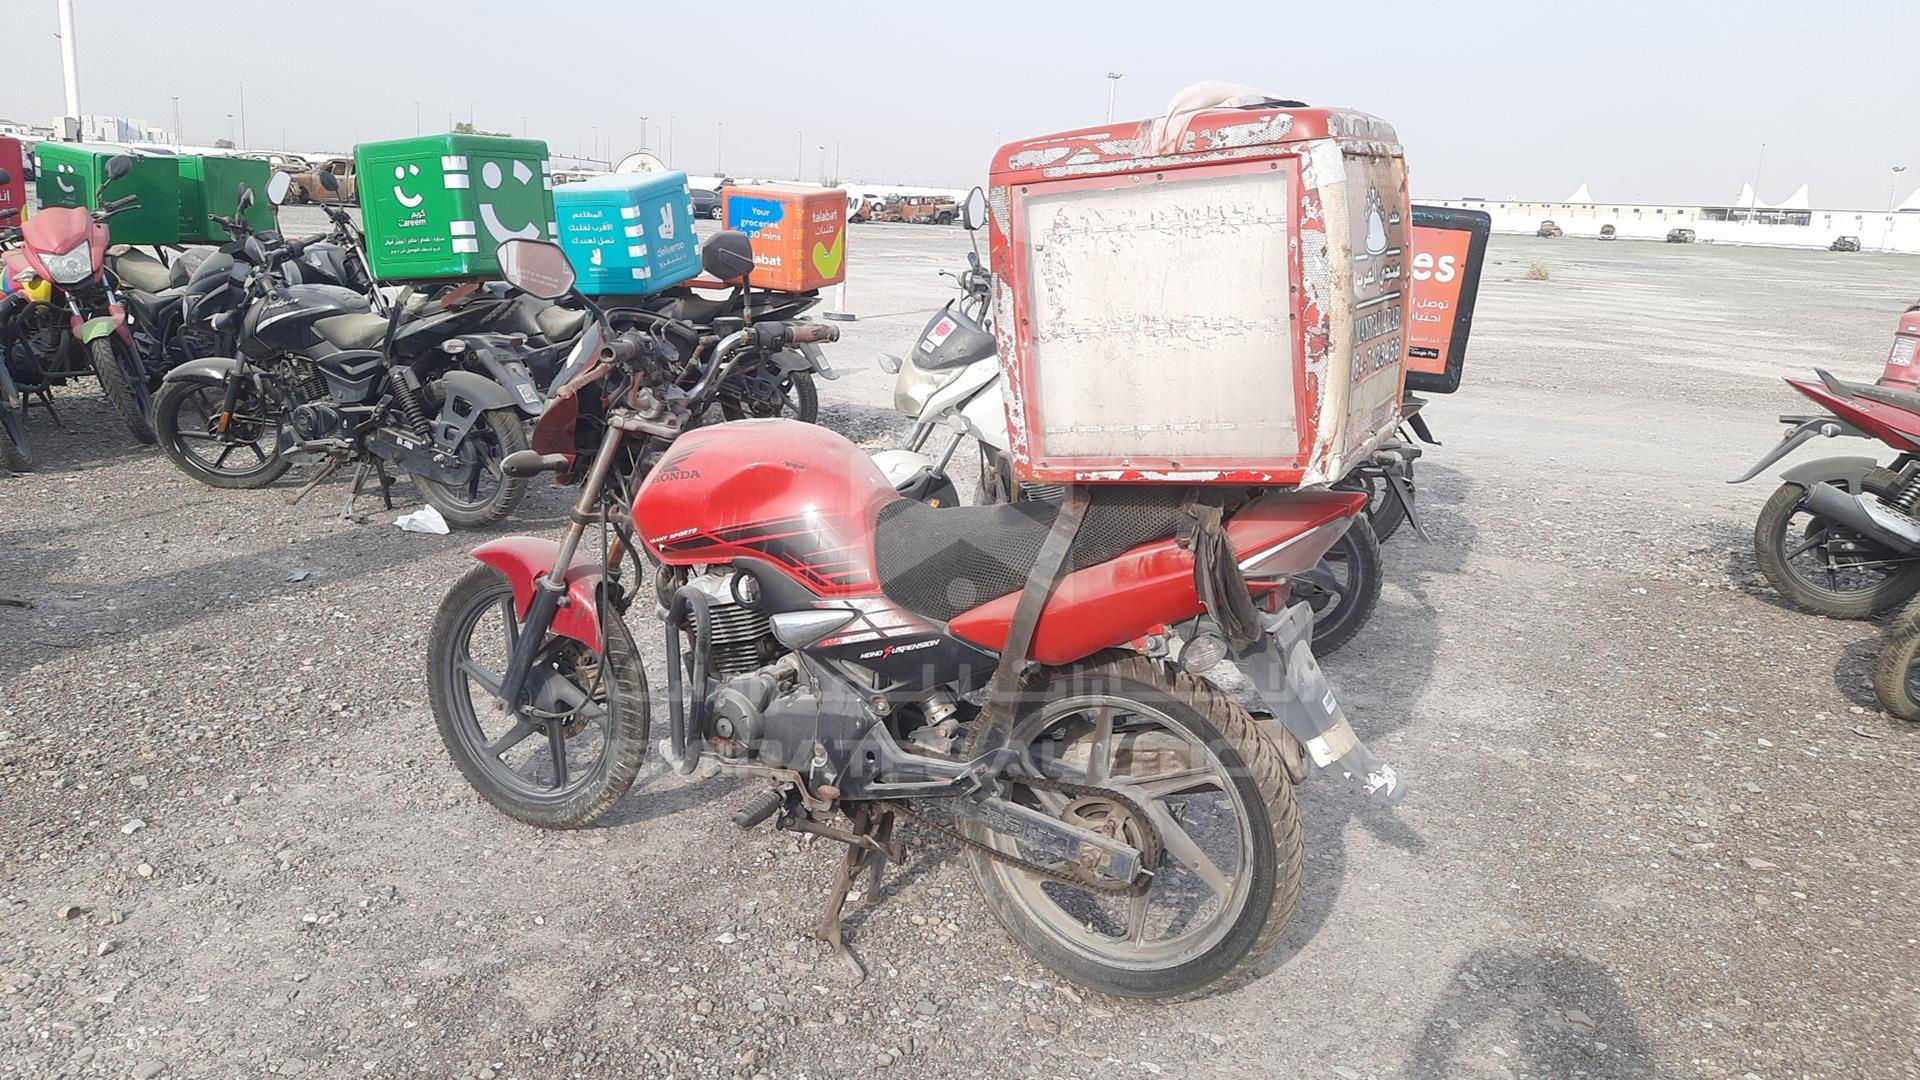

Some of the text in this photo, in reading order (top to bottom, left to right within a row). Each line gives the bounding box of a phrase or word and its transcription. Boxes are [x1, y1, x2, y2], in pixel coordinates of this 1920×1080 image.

[751, 206, 771, 216] Your
[398, 219, 427, 228] Careem
[749, 230, 761, 239] 30
[761, 232, 782, 241] mins
[652, 470, 701, 483] HONDA
[860, 650, 883, 660] MONO
